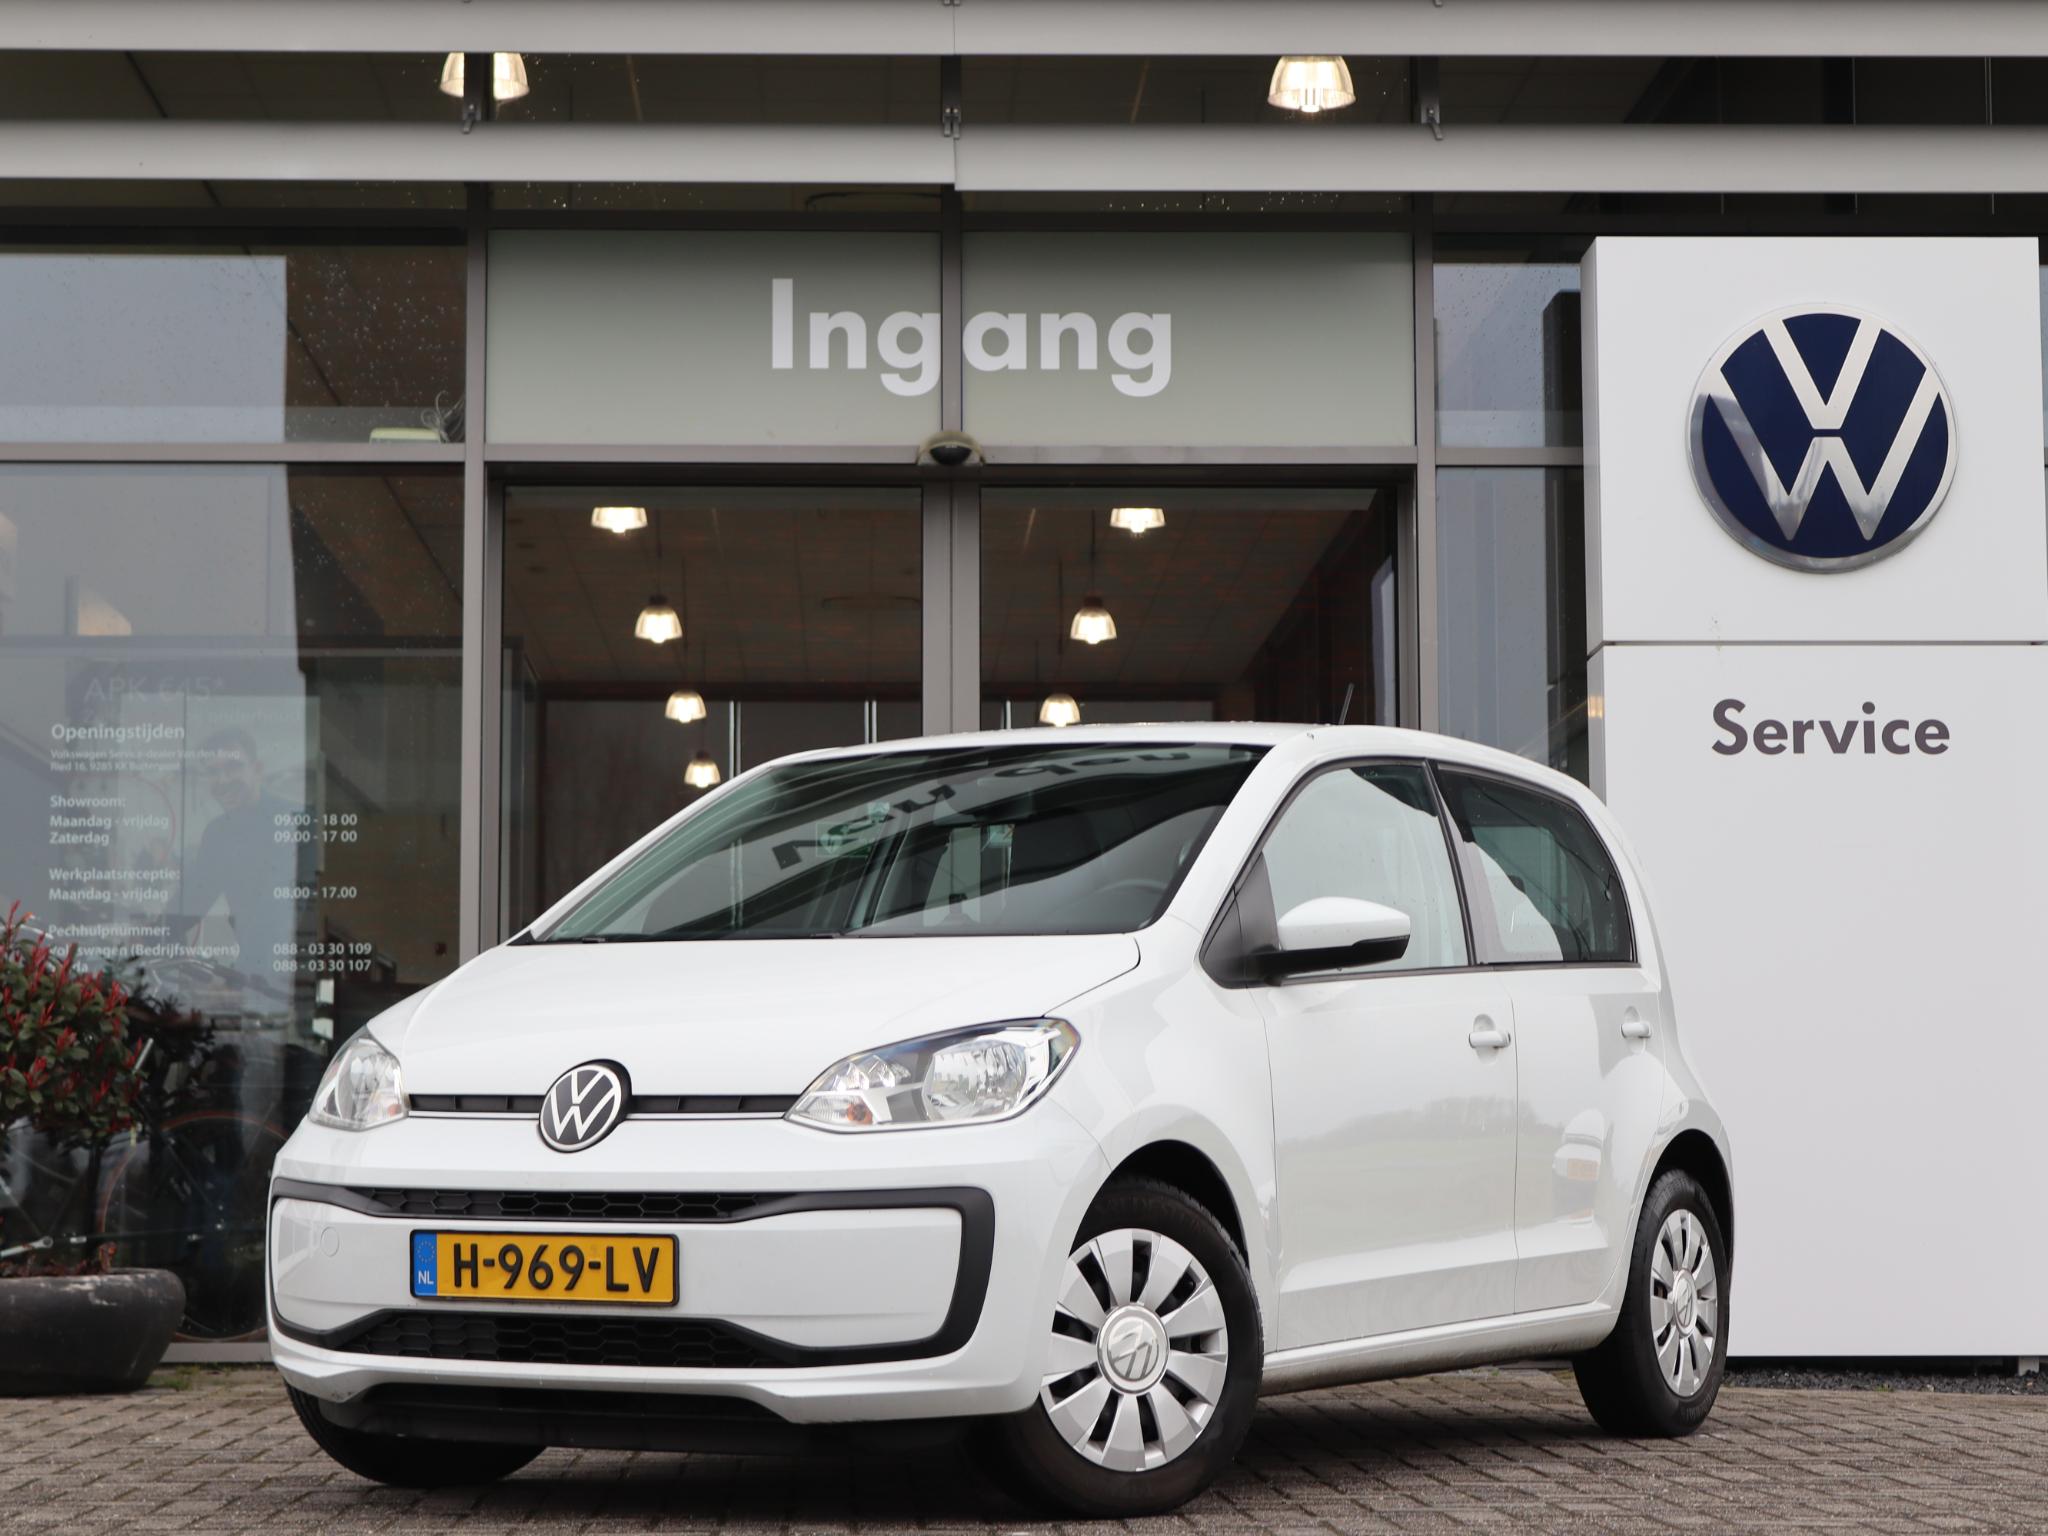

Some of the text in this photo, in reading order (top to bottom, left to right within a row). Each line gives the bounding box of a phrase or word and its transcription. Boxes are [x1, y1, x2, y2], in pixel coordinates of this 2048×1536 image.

[772, 278, 1171, 397] Ingang
[51, 723, 185, 743] Openingstijden
[1711, 698, 1950, 755] Service
[50, 795, 126, 808] Showroom:
[50, 815, 112, 830] Maandag
[122, 815, 169, 830] vrijdag
[49, 831, 110, 846] Zaterdag
[49, 867, 181, 882] Werkplaatsreceptie:
[49, 887, 111, 902] Maandag
[122, 887, 168, 902] vrijdag
[273, 886, 310, 899] 08.00
[322, 886, 357, 899] 17.00
[49, 924, 171, 939] Pechhulpnummer:
[50, 943, 127, 958] Volswagen
[273, 943, 298, 955] 088
[308, 943, 326, 955] 03
[328, 943, 345, 955] 30
[349, 943, 372, 955] 109
[273, 960, 298, 972] 088
[308, 960, 326, 971] 03
[328, 960, 345, 971] 30
[349, 960, 371, 971] 107
[453, 1242, 660, 1294] H-969-LV
[418, 1271, 434, 1285] NL
